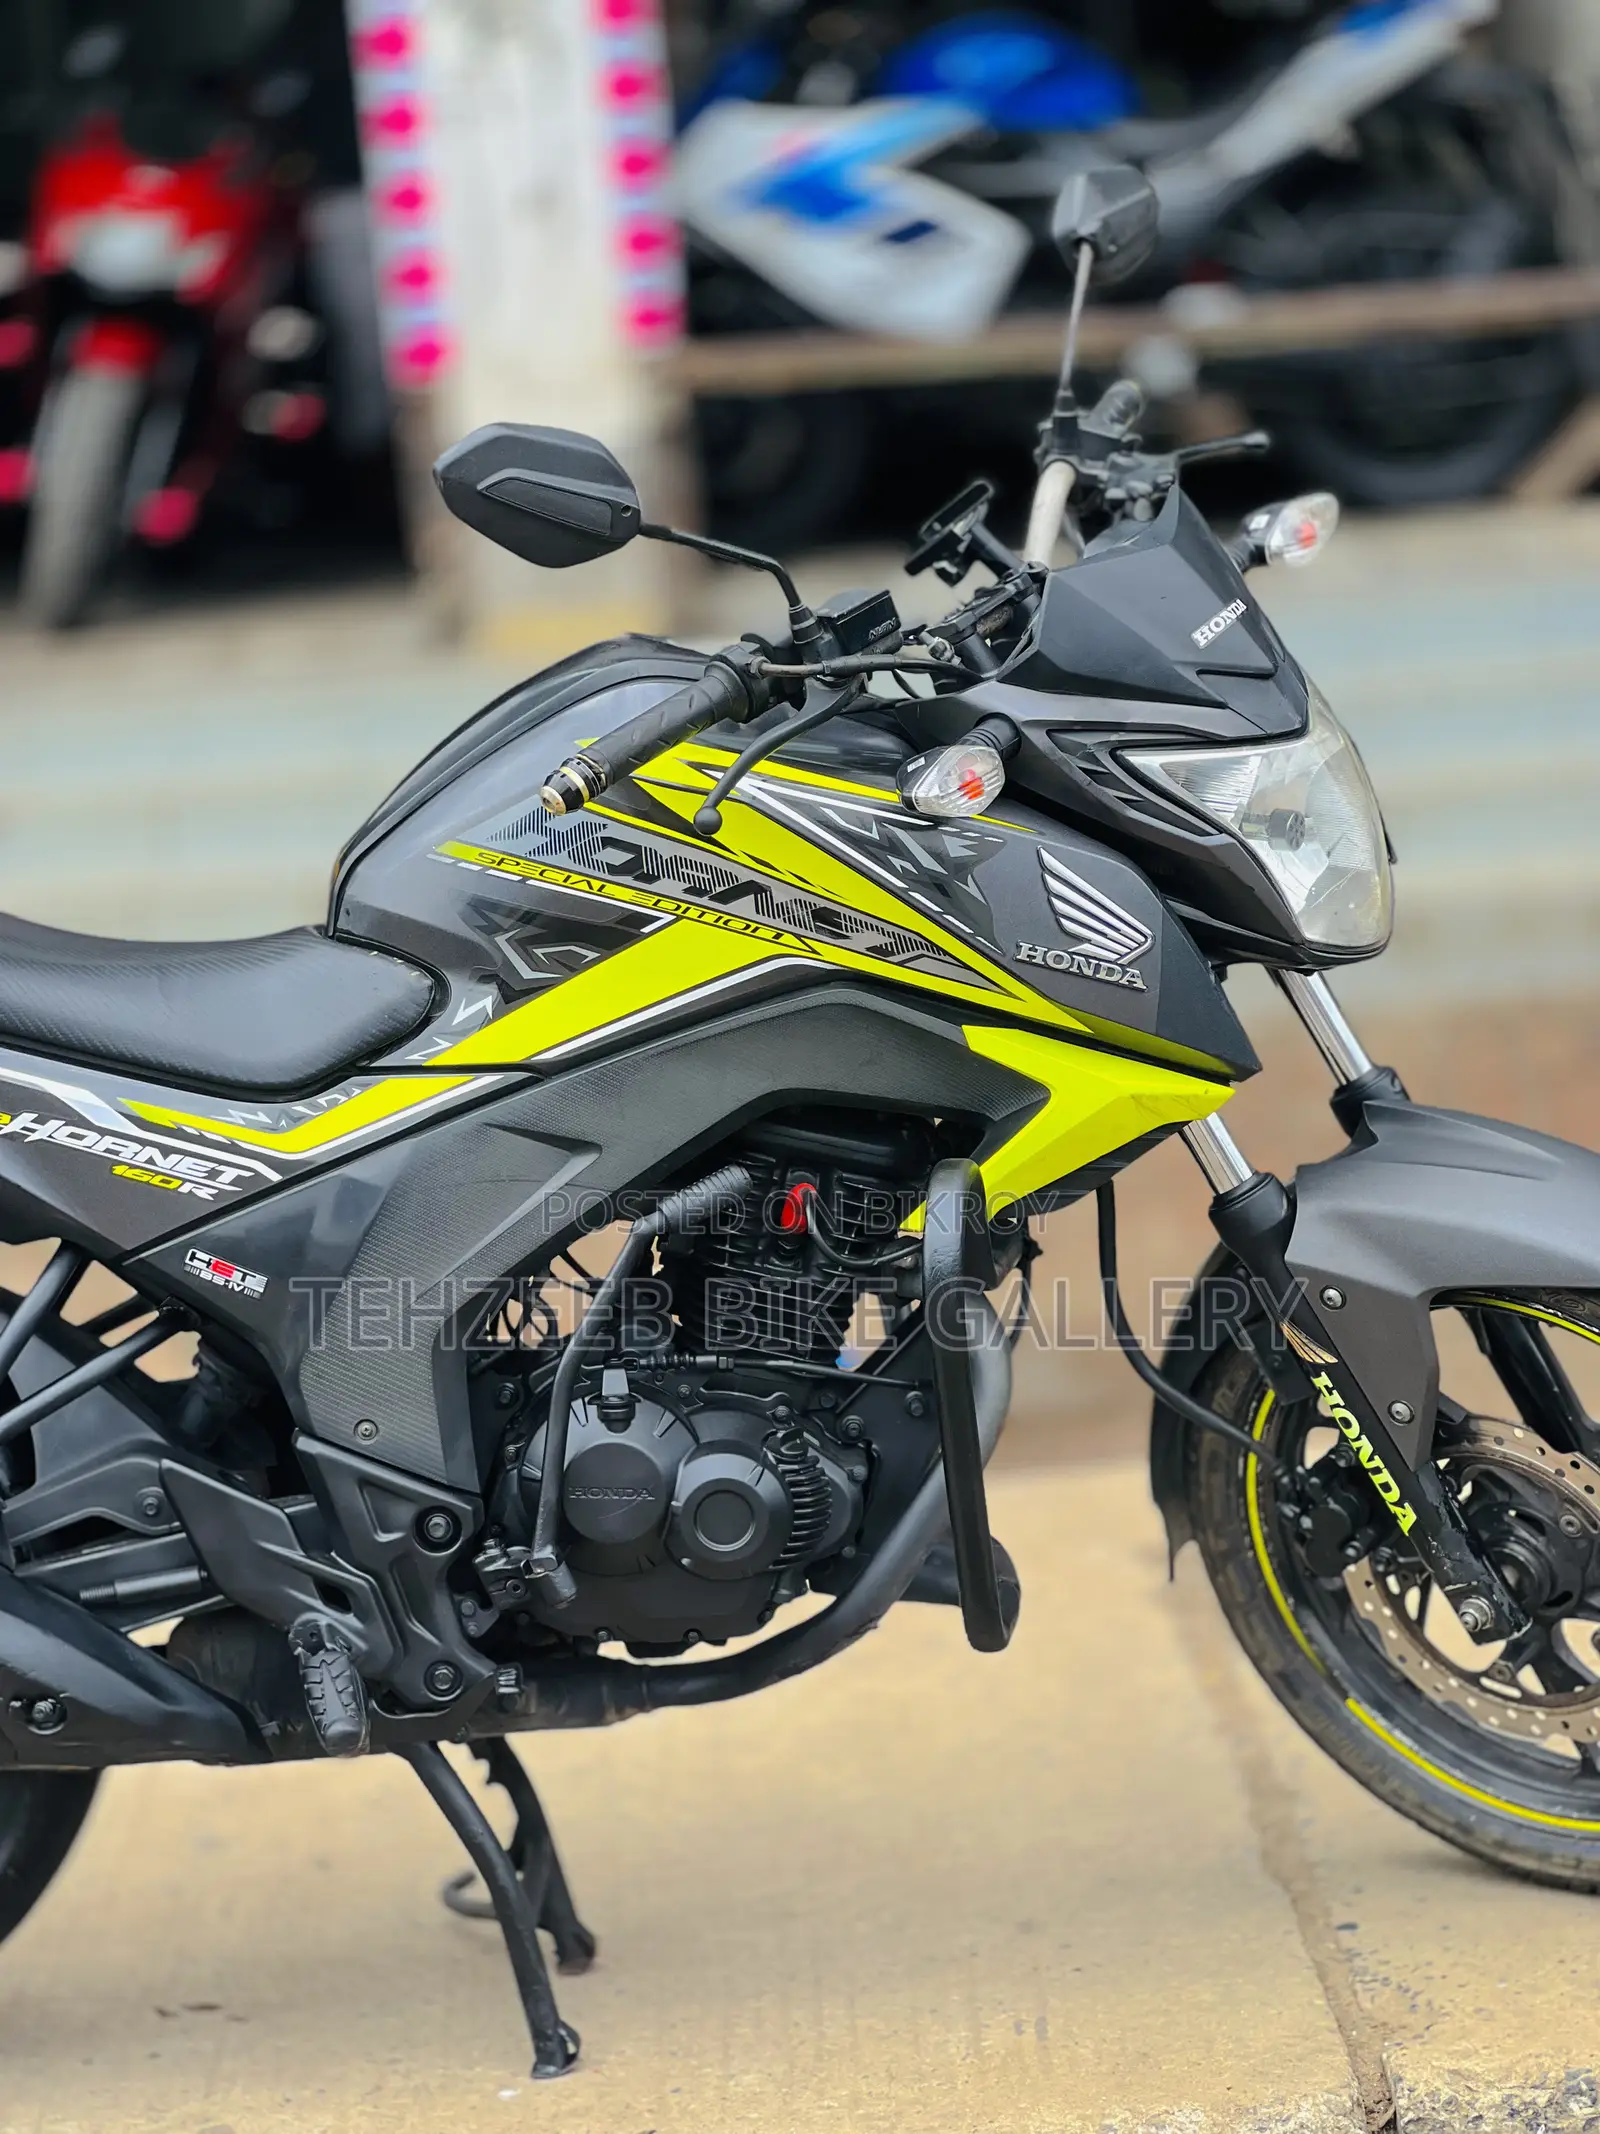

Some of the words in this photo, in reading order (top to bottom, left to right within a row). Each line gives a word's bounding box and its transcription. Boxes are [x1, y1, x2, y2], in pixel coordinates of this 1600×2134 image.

[1191, 598, 1247, 647] HONDA
[477, 851, 616, 897] SPECIAL
[633, 891, 788, 940] EDITION
[1014, 940, 1149, 992] HONDA
[0, 1112, 255, 1190] HORNET
[111, 1164, 219, 1200] 160R
[187, 1250, 257, 1283] HET
[1310, 1371, 1419, 1537] HONDA
[567, 1485, 656, 1501] HONDA
